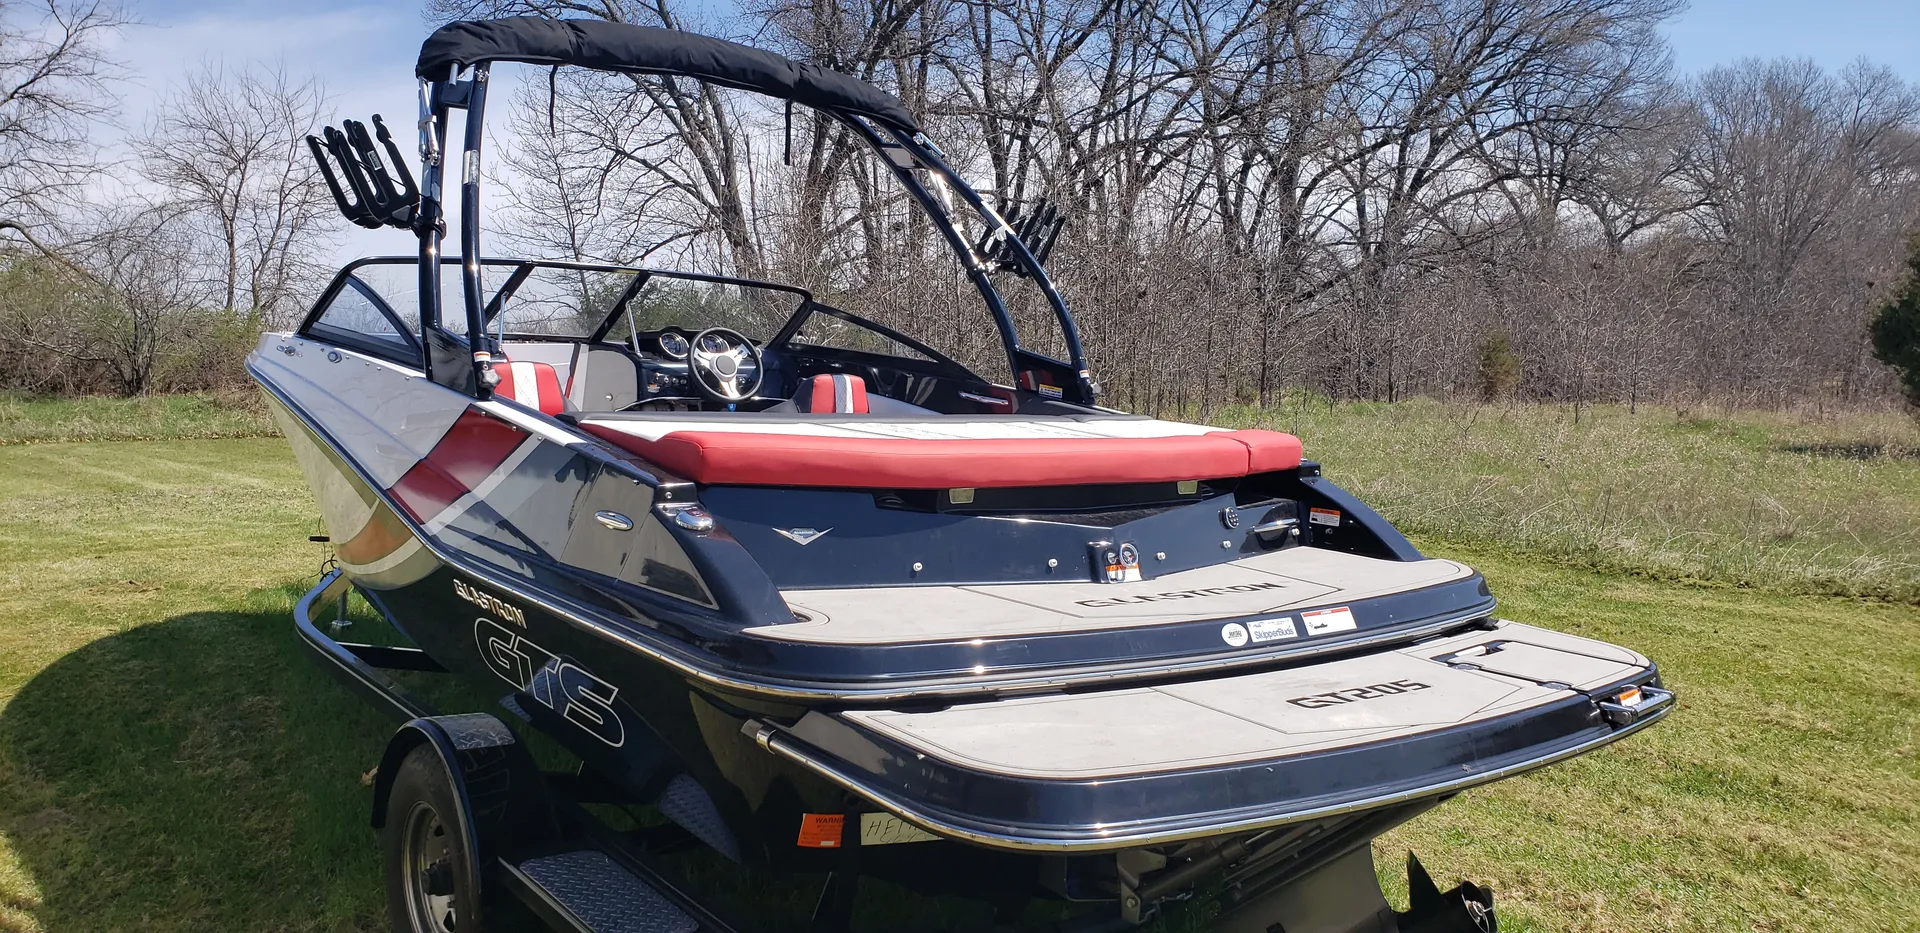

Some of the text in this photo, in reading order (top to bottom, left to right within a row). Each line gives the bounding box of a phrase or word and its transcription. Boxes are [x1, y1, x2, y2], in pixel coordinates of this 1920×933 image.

[453, 578, 528, 629] GLASTRON
[1074, 582, 1285, 608] GLASTRON
[474, 617, 625, 747] GTS
[1286, 679, 1431, 709] GT205
